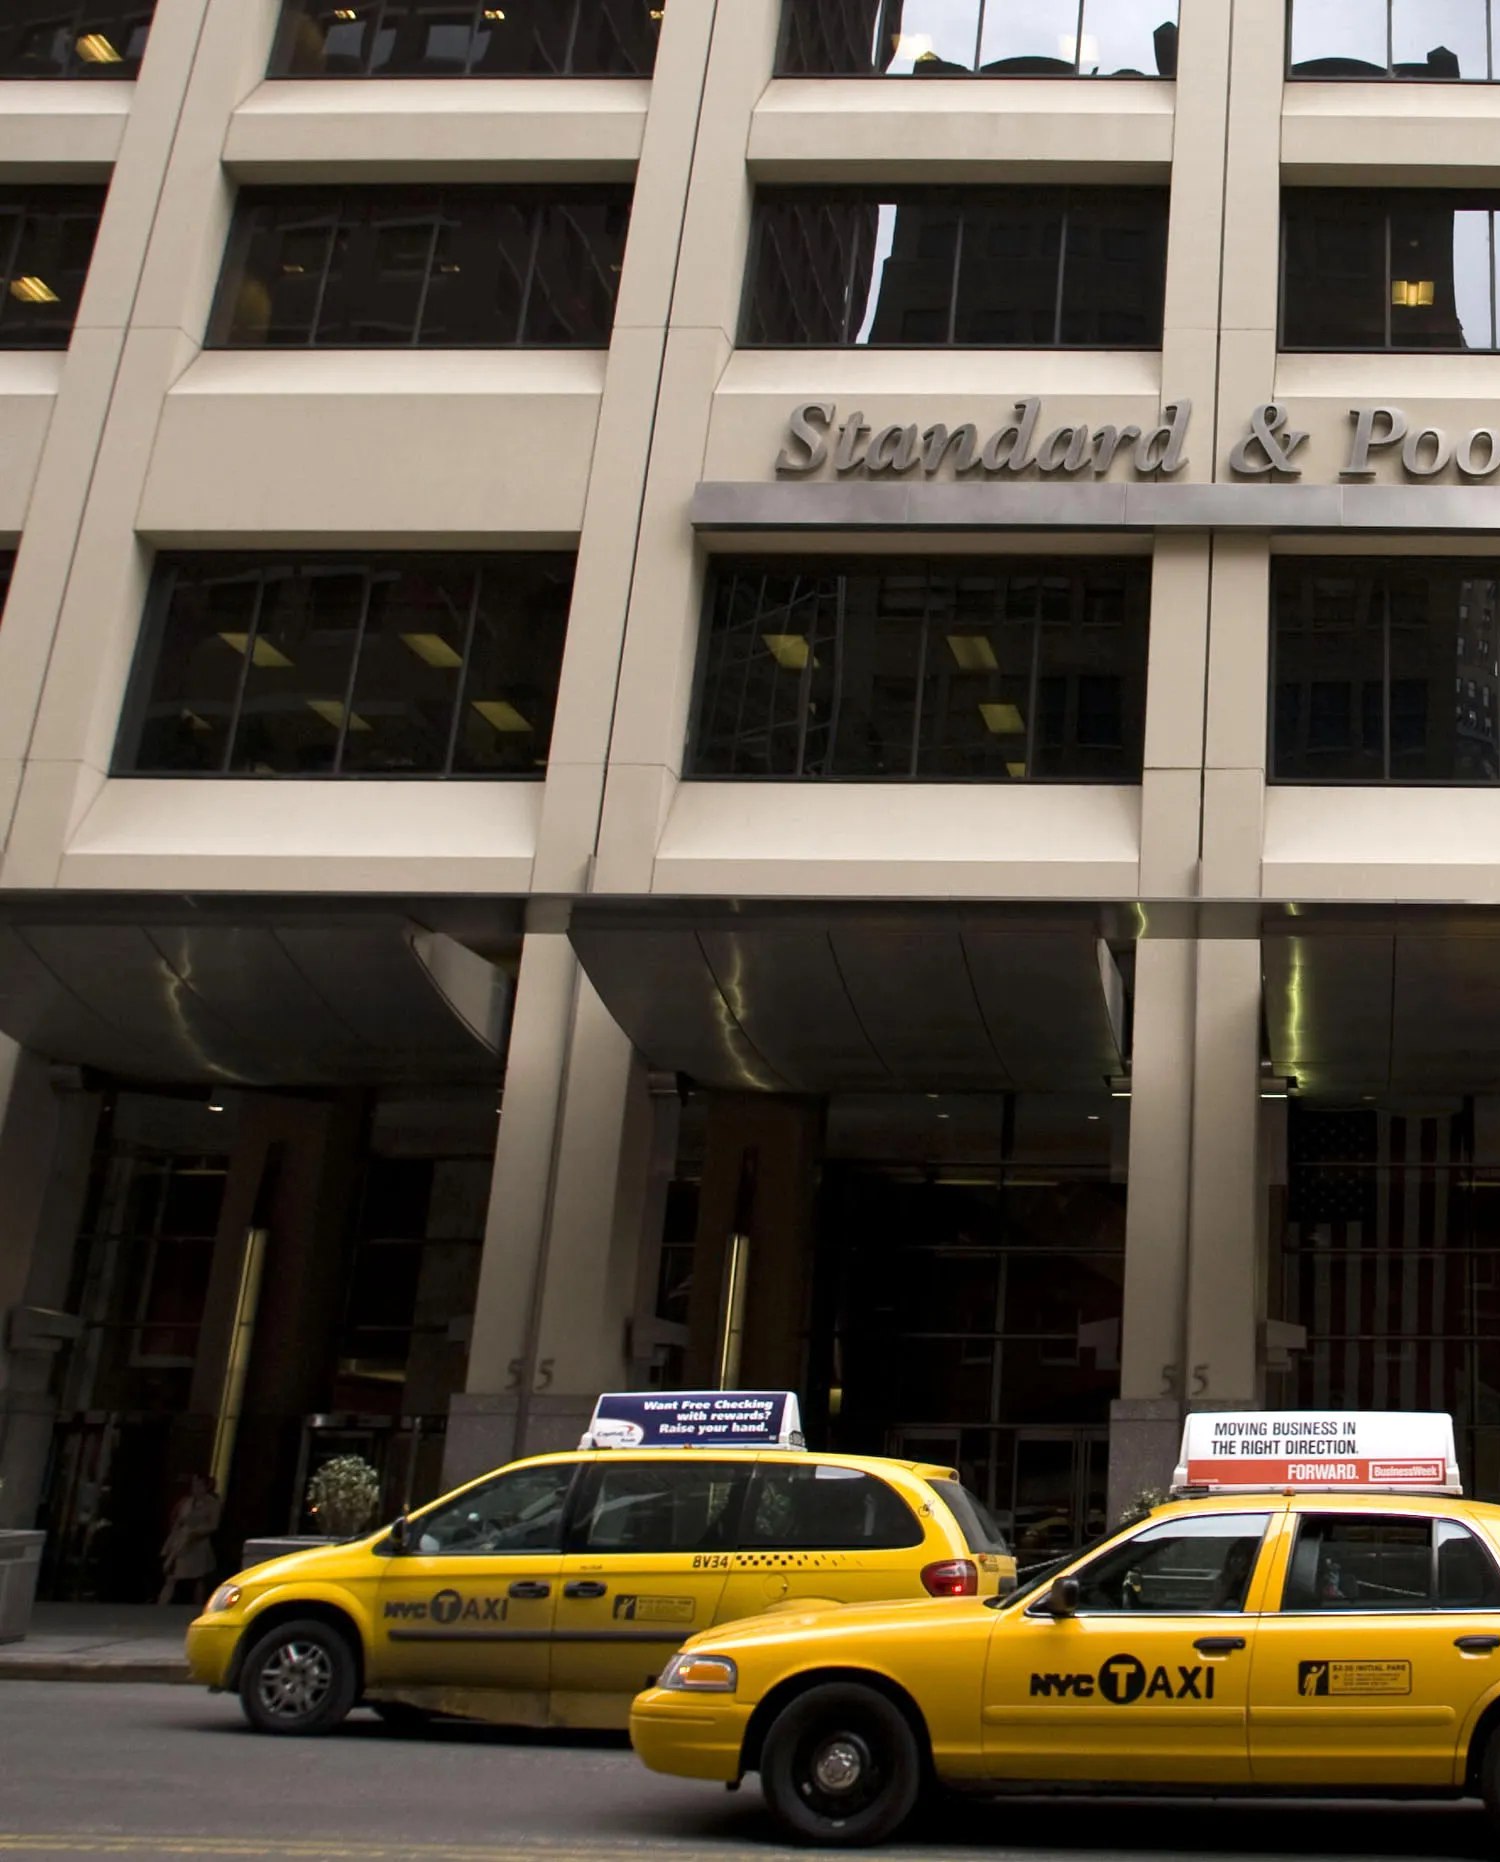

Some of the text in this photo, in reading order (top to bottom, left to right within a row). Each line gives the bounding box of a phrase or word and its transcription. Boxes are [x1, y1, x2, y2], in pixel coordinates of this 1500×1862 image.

[773, 397, 1193, 474] Standard
[1229, 402, 1310, 476] &
[643, 1400, 774, 1411] Want Free Checking
[677, 1411, 772, 1421] with rewards?
[659, 1422, 769, 1435] Raise your hand.
[1214, 1421, 1357, 1436] MOVING BUSINESS IN
[1211, 1440, 1360, 1455] THE RIGHT DIRECTION.
[1287, 1463, 1360, 1481] FORWARD.
[1373, 1465, 1439, 1477] BusinessWeek
[692, 1555, 729, 1569] 8V34
[383, 1588, 510, 1625] NYC TAXI
[1030, 1653, 1215, 1706] NYC TAXI
